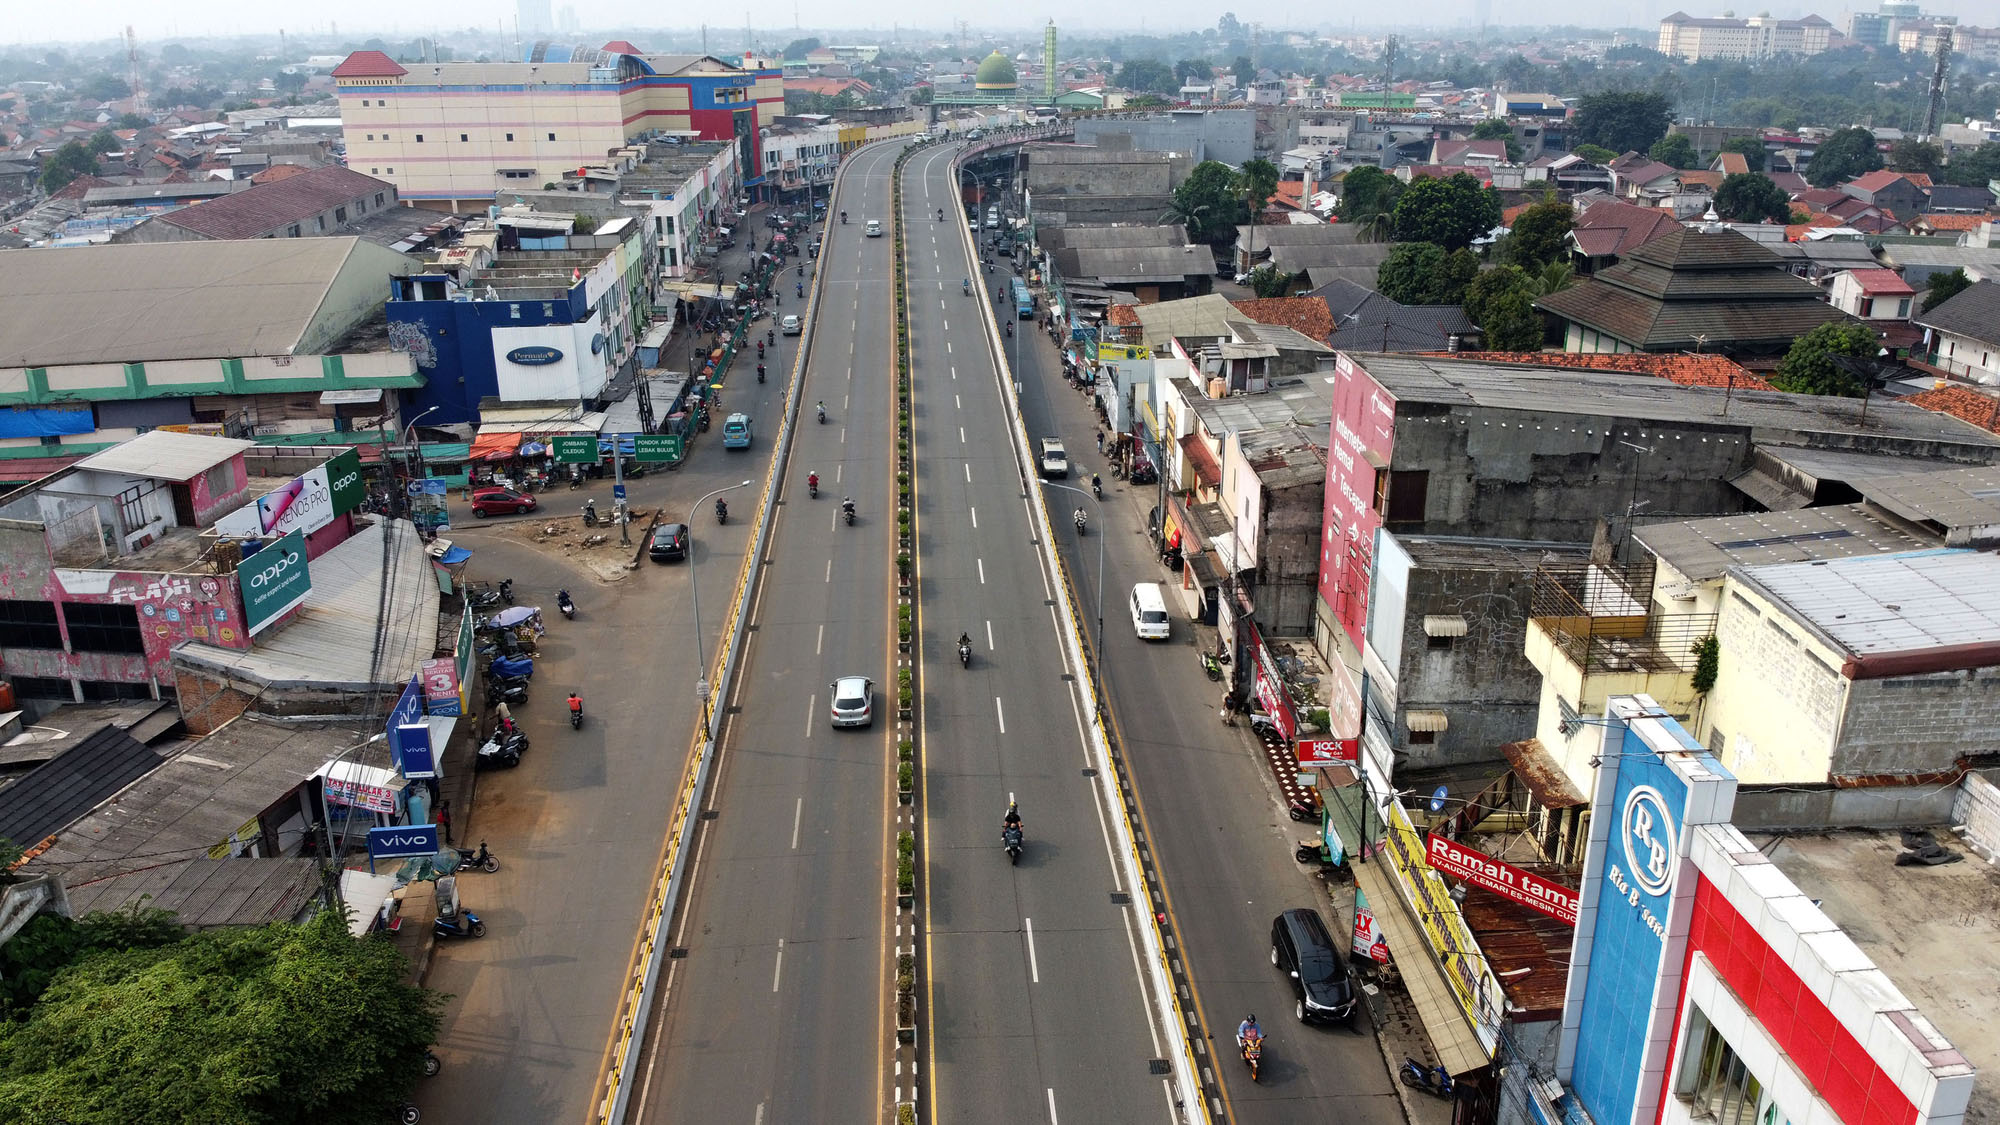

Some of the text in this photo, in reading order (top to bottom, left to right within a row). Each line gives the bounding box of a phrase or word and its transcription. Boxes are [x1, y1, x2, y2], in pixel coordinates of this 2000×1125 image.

[1334, 438, 1354, 475] Hemat
[333, 471, 357, 492] oppo
[1340, 473, 1367, 519] Tercepat
[280, 486, 329, 527] RENO3 PRO
[250, 551, 299, 588] oppo
[111, 574, 191, 604] FLASH
[254, 570, 302, 606] Selfie expert and leader
[428, 689, 457, 698] MENIT
[430, 673, 453, 693] 3
[1312, 741, 1343, 751] HOCK
[346, 782, 383, 796] CELLULAR
[385, 789, 392, 798] 3
[380, 834, 427, 847] vivo
[1432, 838, 1513, 884] Ramah
[1431, 857, 1509, 894] TV-AUDIO-LEMARI
[1510, 889, 1555, 914] ES-MESIN
[1608, 864, 1629, 895] Ria
[1355, 913, 1373, 935] 1X
